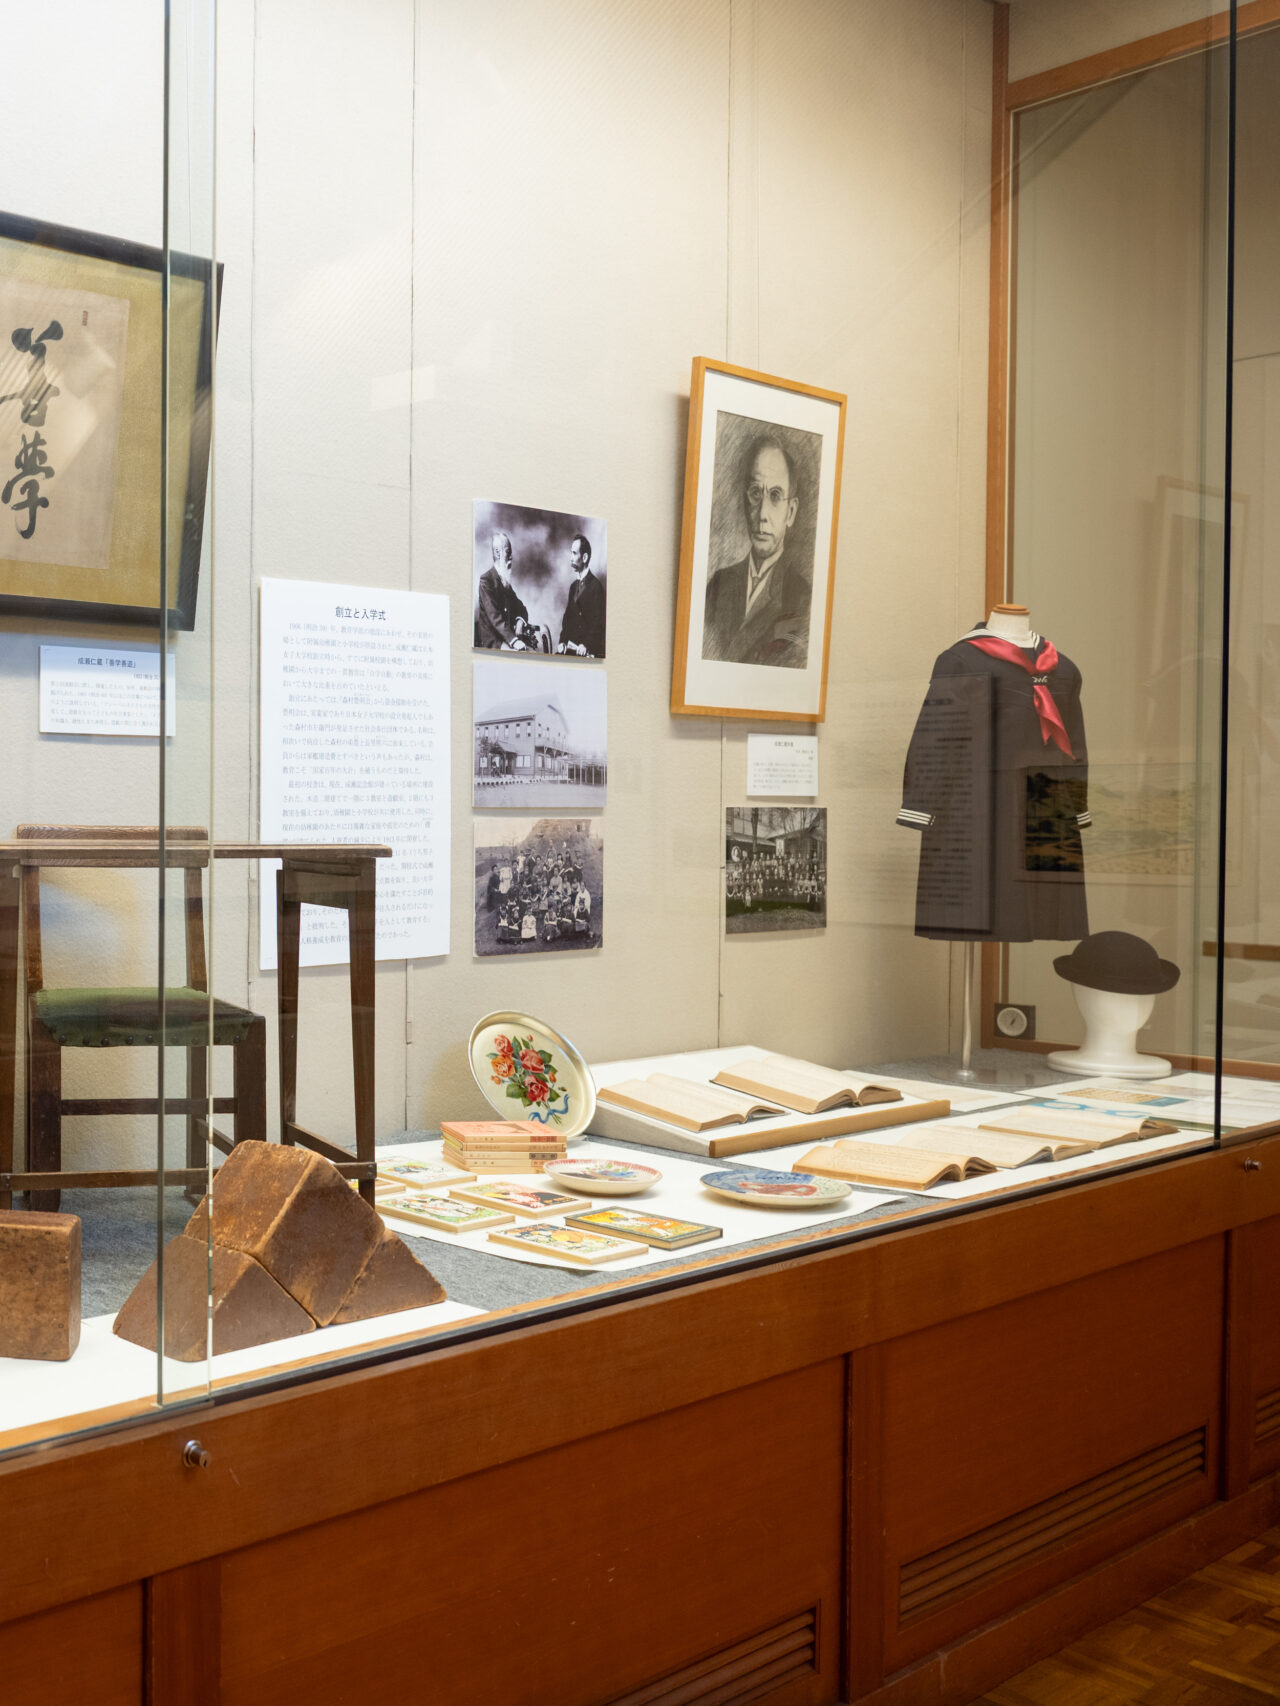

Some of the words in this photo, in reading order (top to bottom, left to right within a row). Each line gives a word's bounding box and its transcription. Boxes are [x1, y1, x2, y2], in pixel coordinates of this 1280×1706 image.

[335, 606, 387, 621] 創立と入学式
